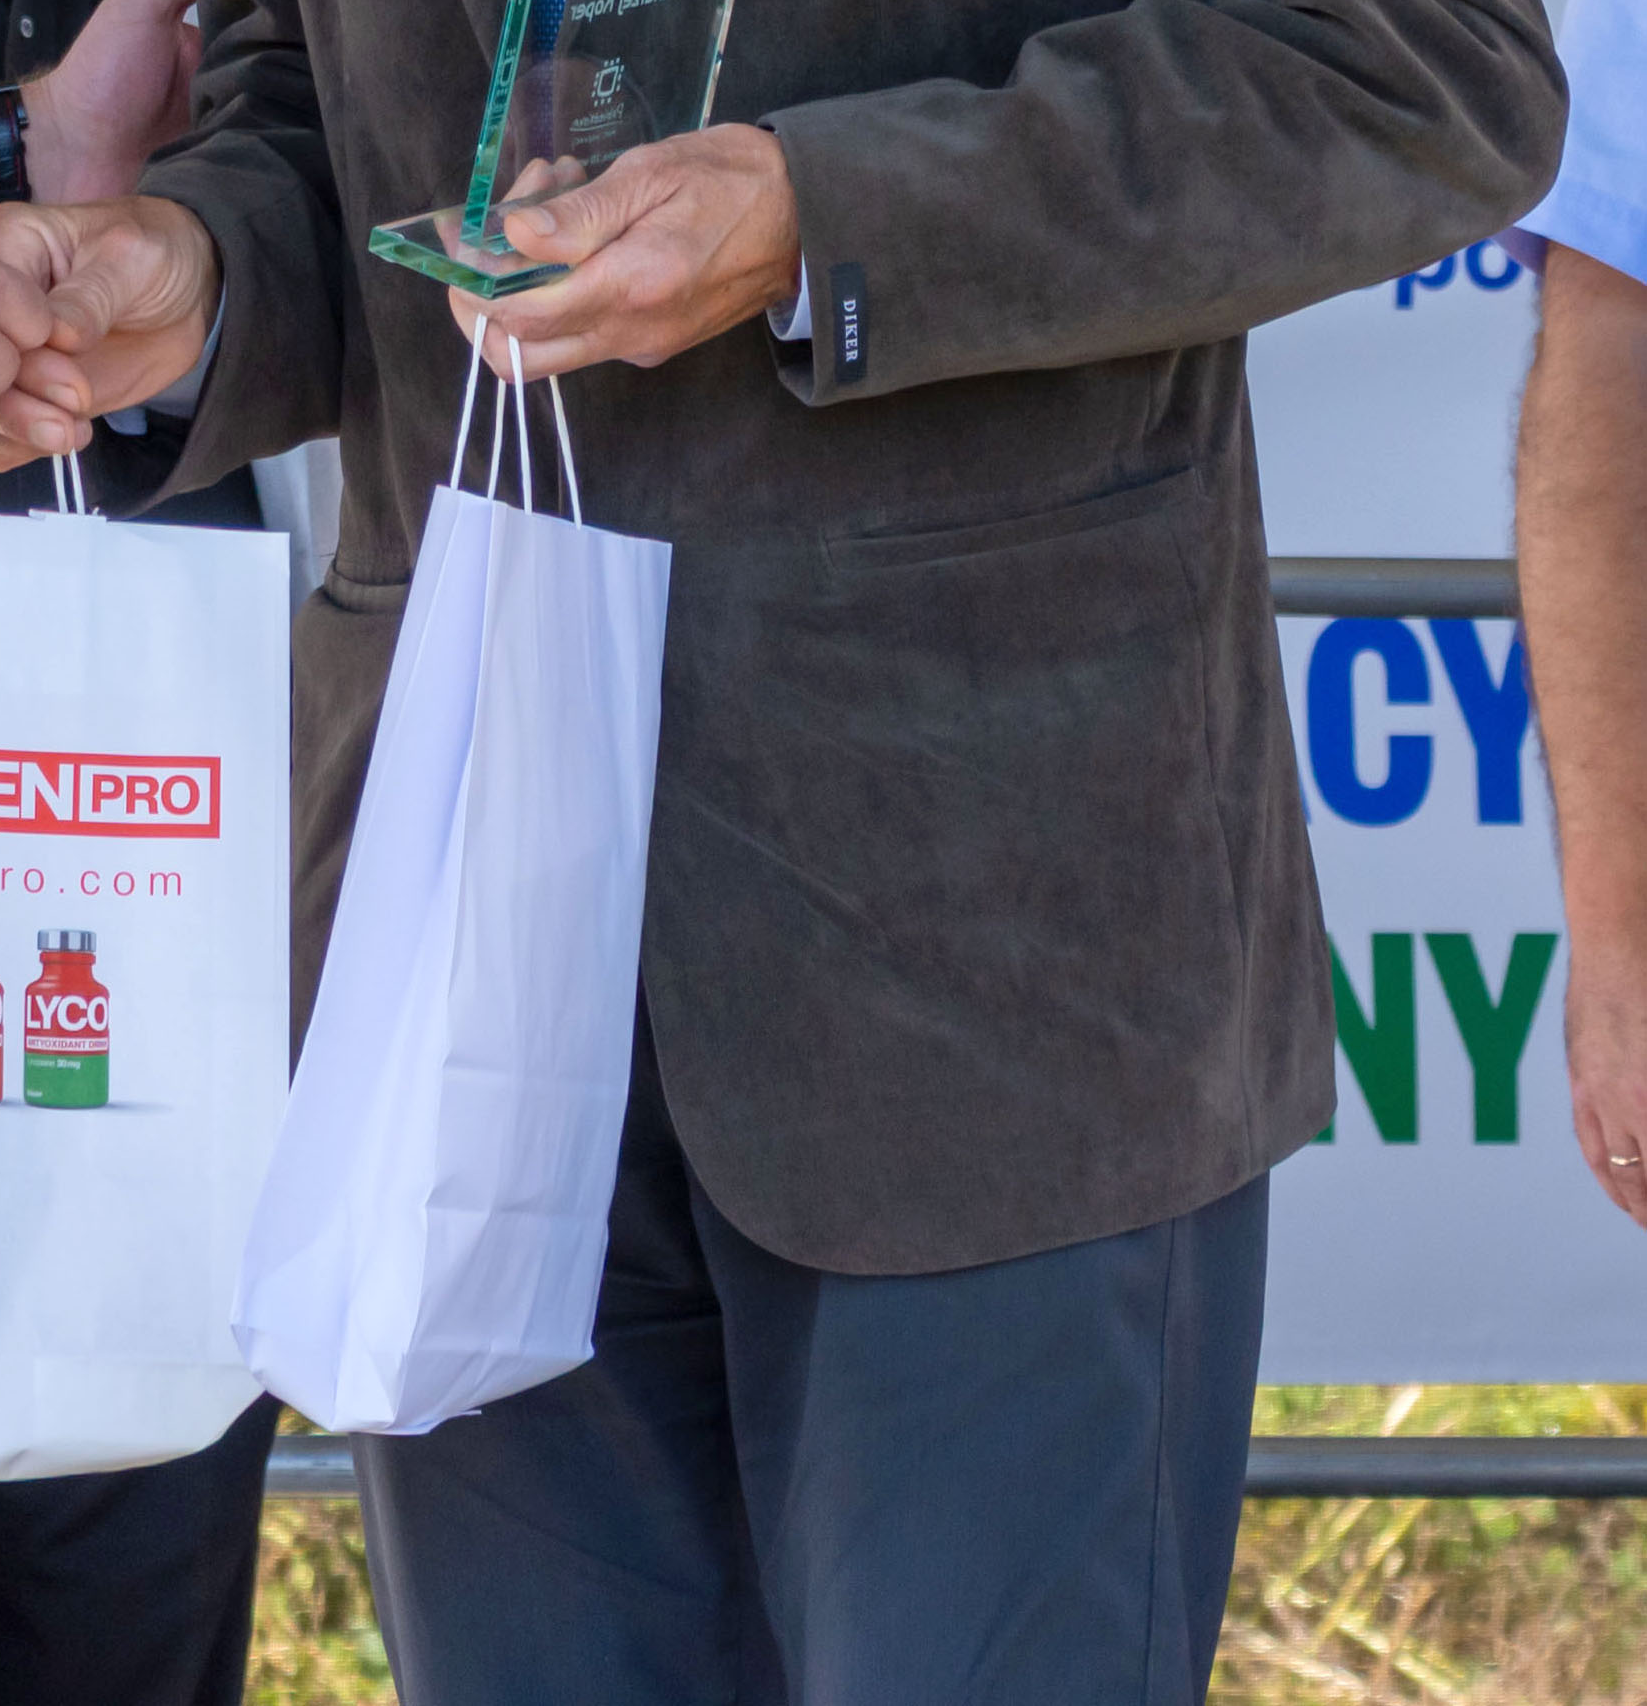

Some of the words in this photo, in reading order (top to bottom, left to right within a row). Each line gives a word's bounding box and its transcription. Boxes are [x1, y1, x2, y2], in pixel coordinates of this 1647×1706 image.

[843, 298, 859, 363] DIKER
[91, 773, 201, 817] PRO
[26, 994, 109, 1032] LYCO
